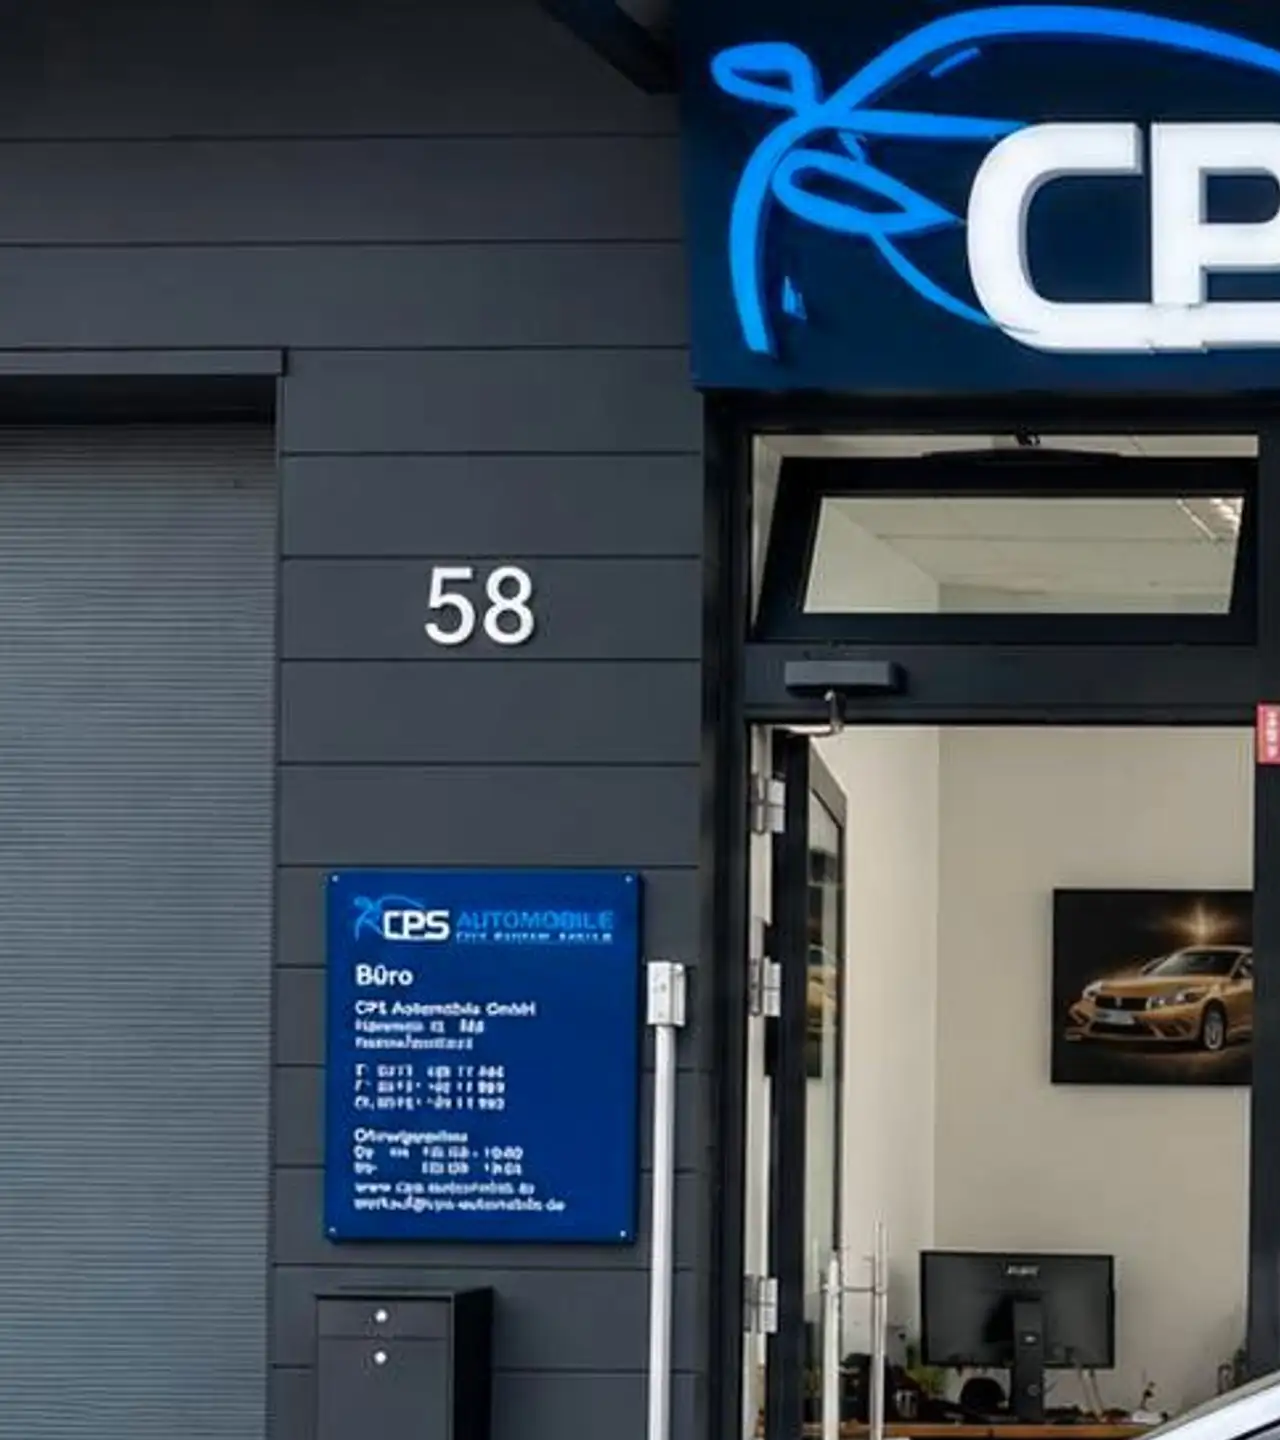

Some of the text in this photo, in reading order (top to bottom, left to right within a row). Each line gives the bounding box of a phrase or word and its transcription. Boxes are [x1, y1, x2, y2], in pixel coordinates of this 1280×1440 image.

[424, 565, 534, 645] 58
[383, 909, 451, 941] CPS
[456, 909, 615, 931] AUTOMOBILE
[355, 963, 414, 986] Büro
